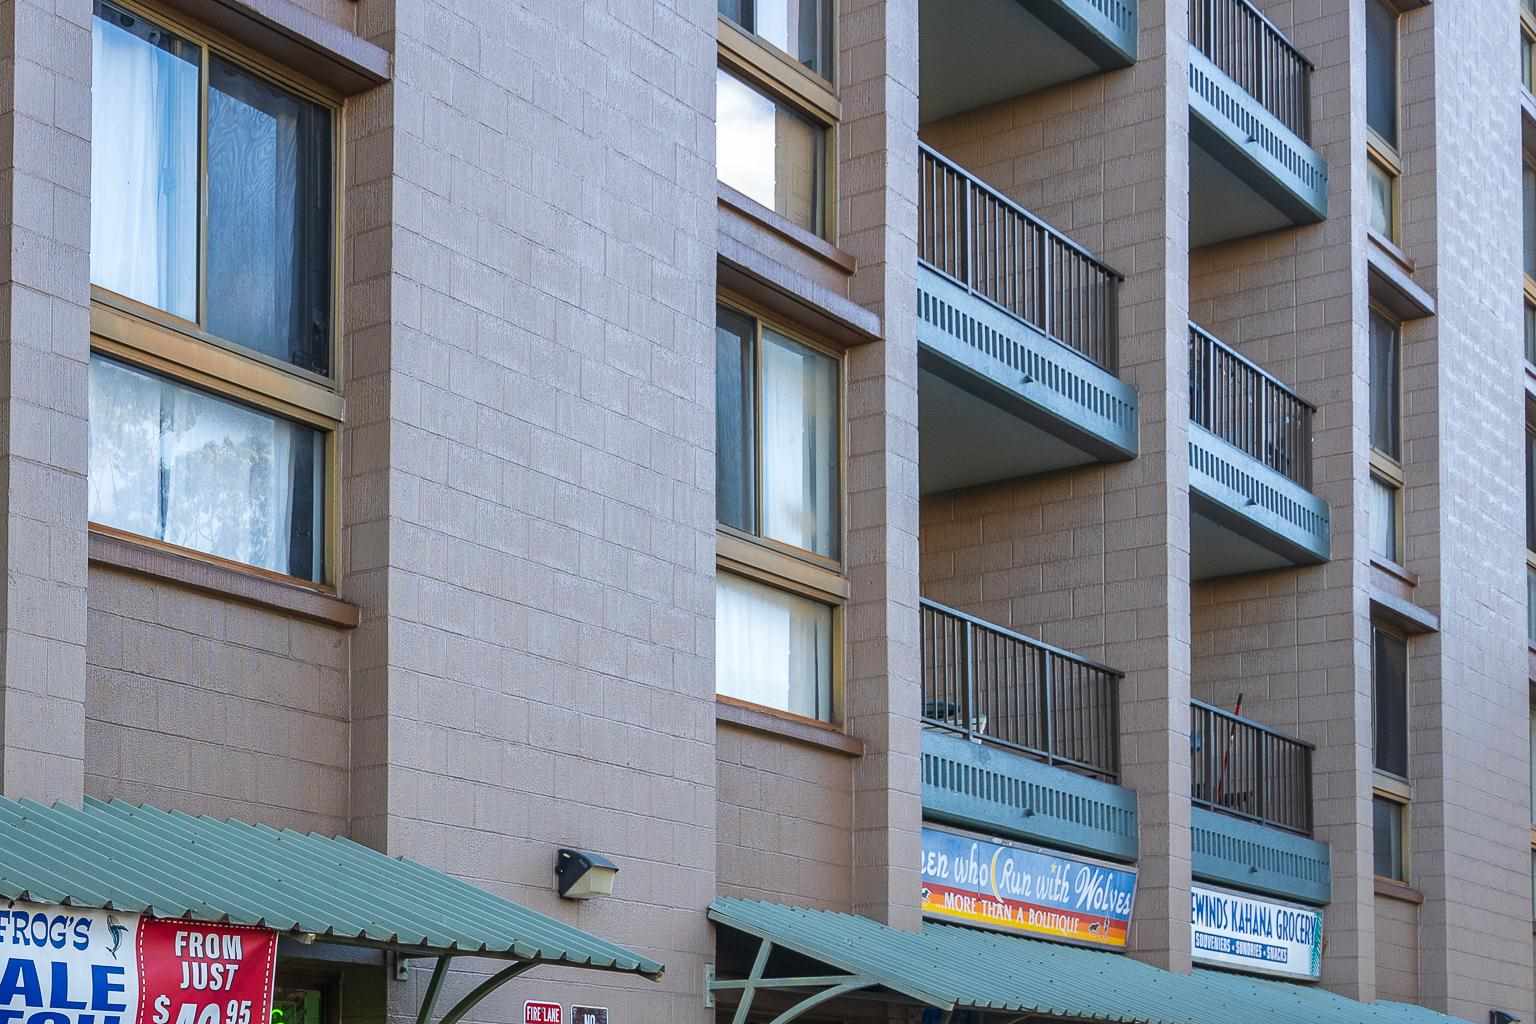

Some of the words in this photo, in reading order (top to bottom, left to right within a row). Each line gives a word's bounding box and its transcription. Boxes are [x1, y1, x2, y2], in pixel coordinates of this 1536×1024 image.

[954, 842, 989, 887] who
[1000, 858, 1031, 896] Run
[1037, 863, 1070, 904] with
[982, 900, 1013, 921] THAN
[1016, 907, 1024, 923] A
[1231, 901, 1273, 938] KAHANA
[1276, 909, 1316, 945] GROCERY
[175, 931, 243, 960] FROM
[180, 961, 239, 991] JUST
[527, 1006, 541, 1021] FIRE
[543, 1007, 560, 1022] LANE
